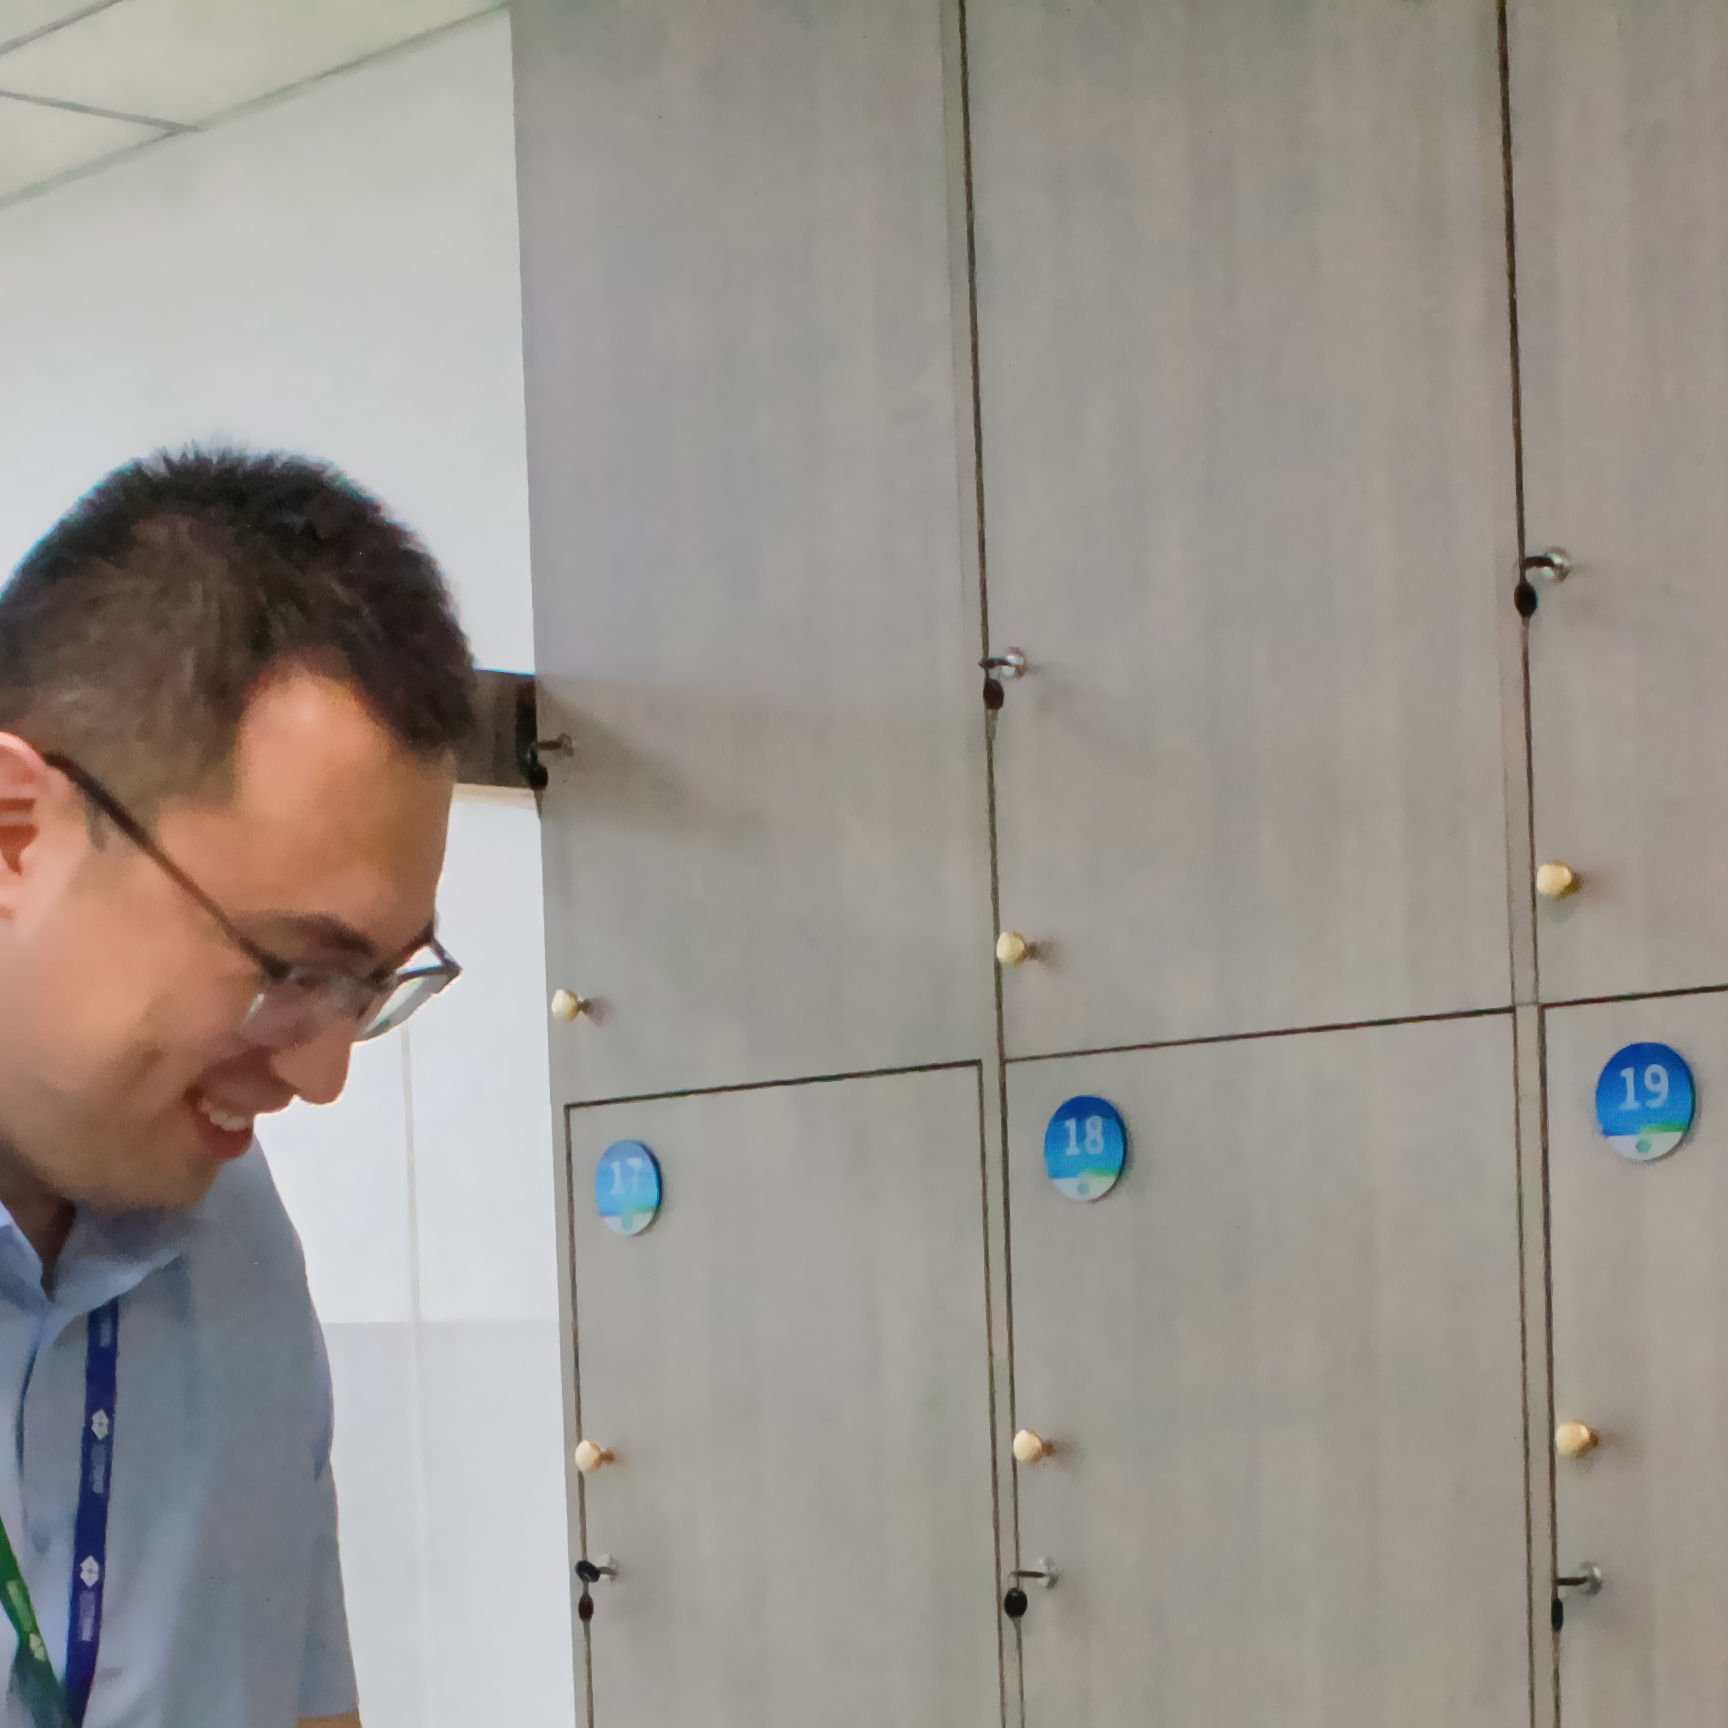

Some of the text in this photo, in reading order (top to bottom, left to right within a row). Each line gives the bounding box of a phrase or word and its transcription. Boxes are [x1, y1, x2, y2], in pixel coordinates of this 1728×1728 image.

[1619, 1064, 1669, 1110] 19
[1064, 1115, 1104, 1156] 18
[610, 1157, 643, 1195] 17
